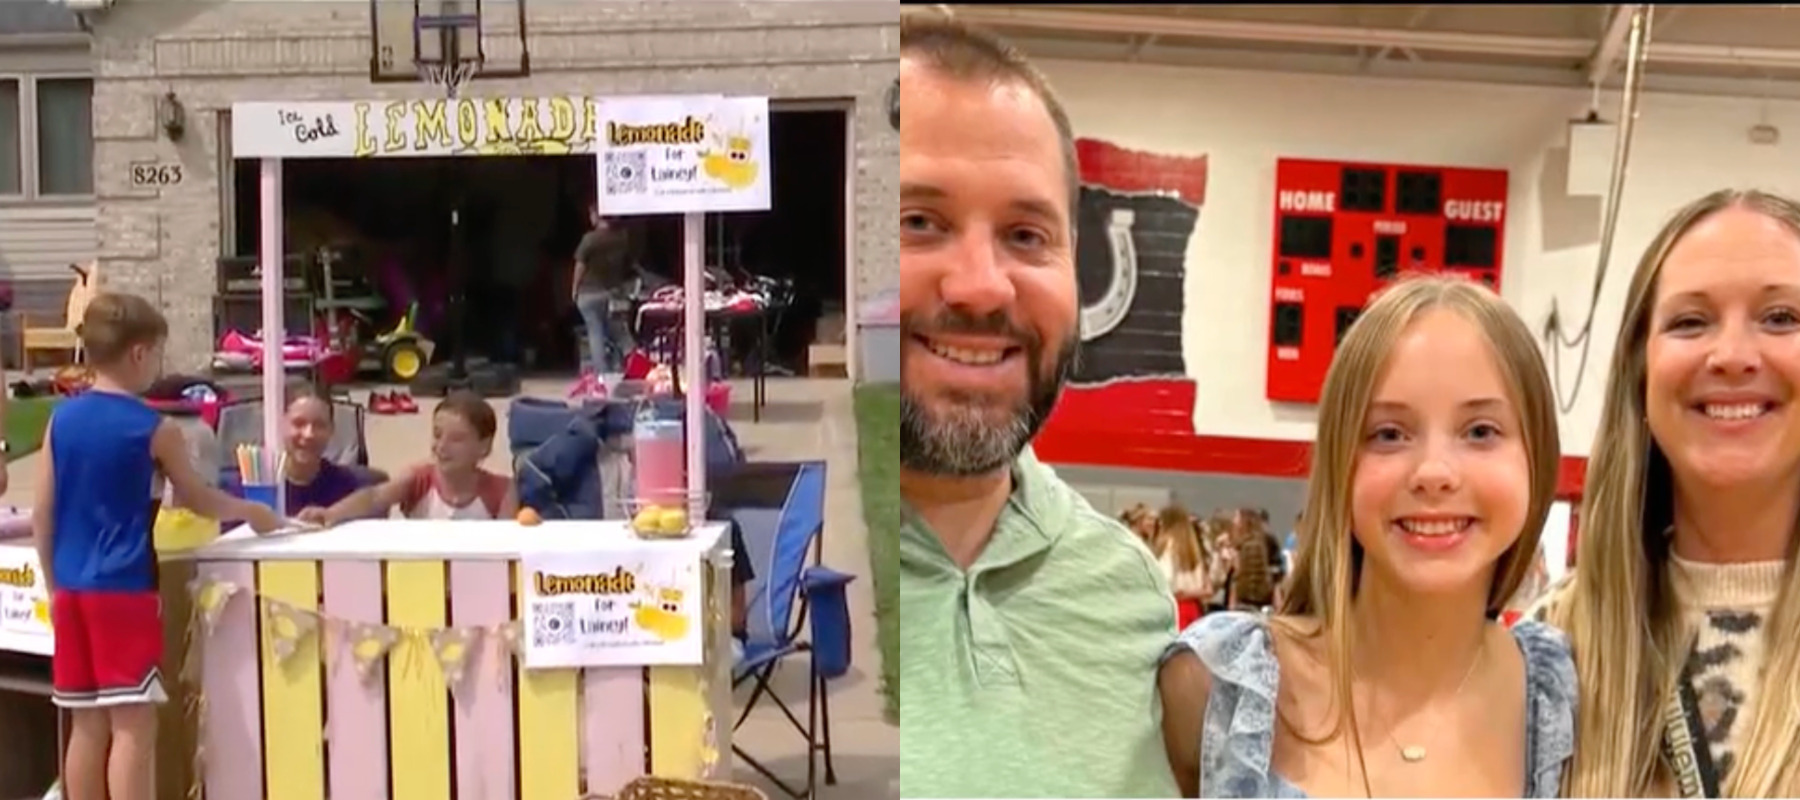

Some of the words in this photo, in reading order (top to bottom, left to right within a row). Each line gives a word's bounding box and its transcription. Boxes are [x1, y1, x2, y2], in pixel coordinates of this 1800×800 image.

[295, 115, 339, 143] Cold
[607, 115, 704, 145] Lemonade
[134, 165, 182, 185] 8263
[1279, 190, 1335, 212] HOME
[1444, 200, 1503, 221] GUEST
[534, 566, 635, 596] Lemonade
